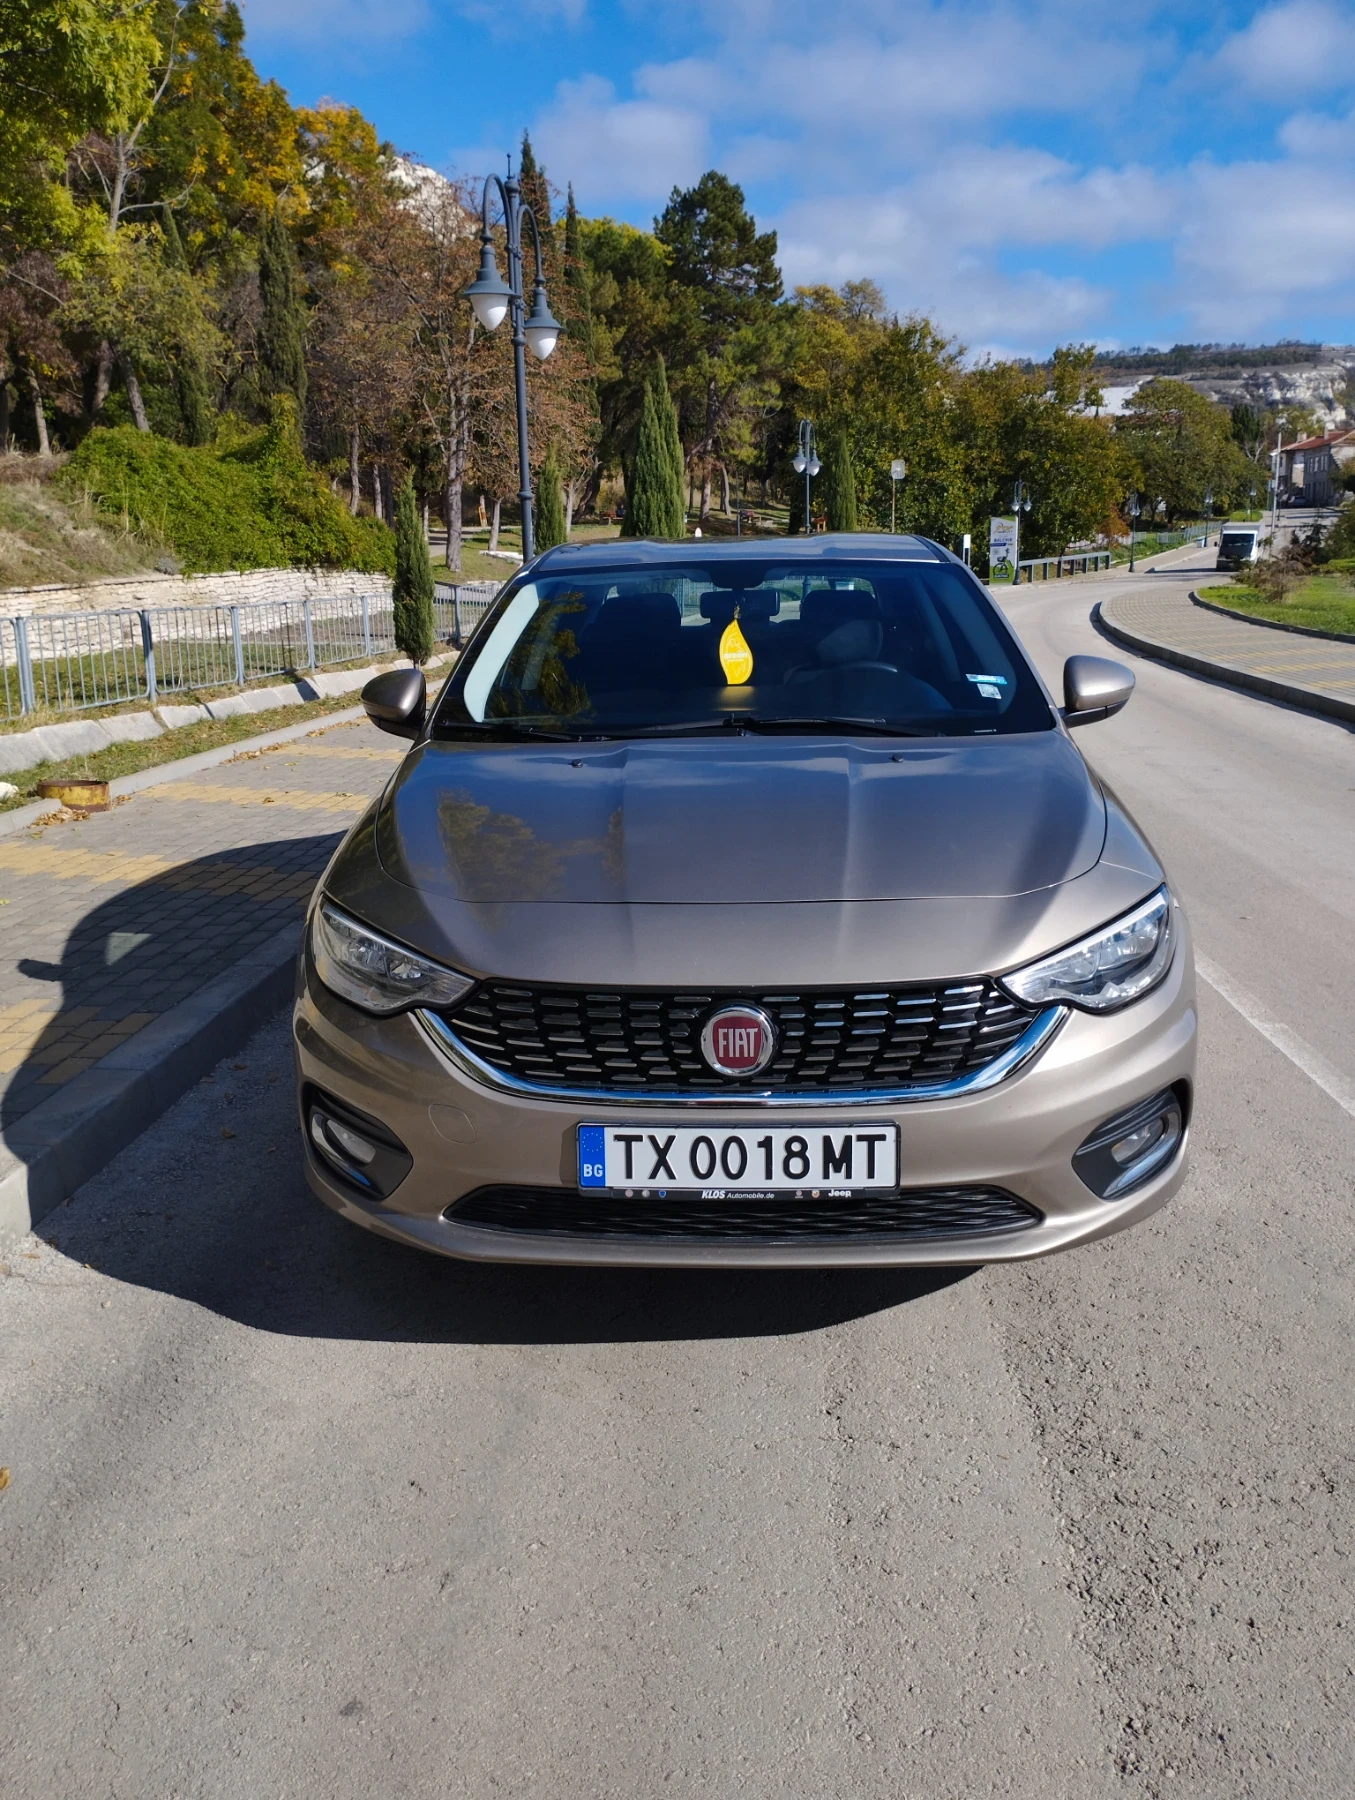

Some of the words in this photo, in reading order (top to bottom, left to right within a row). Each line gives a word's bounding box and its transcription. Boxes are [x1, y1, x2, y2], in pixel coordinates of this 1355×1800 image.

[718, 1028, 758, 1057] FIAT
[613, 1134, 676, 1180] TX
[689, 1135, 811, 1180] 0018
[822, 1134, 887, 1180] MT
[583, 1163, 603, 1177] BG
[701, 1189, 726, 1199] KLOS
[726, 1191, 775, 1199] Automobile.de
[828, 1188, 852, 1198] Jeep
